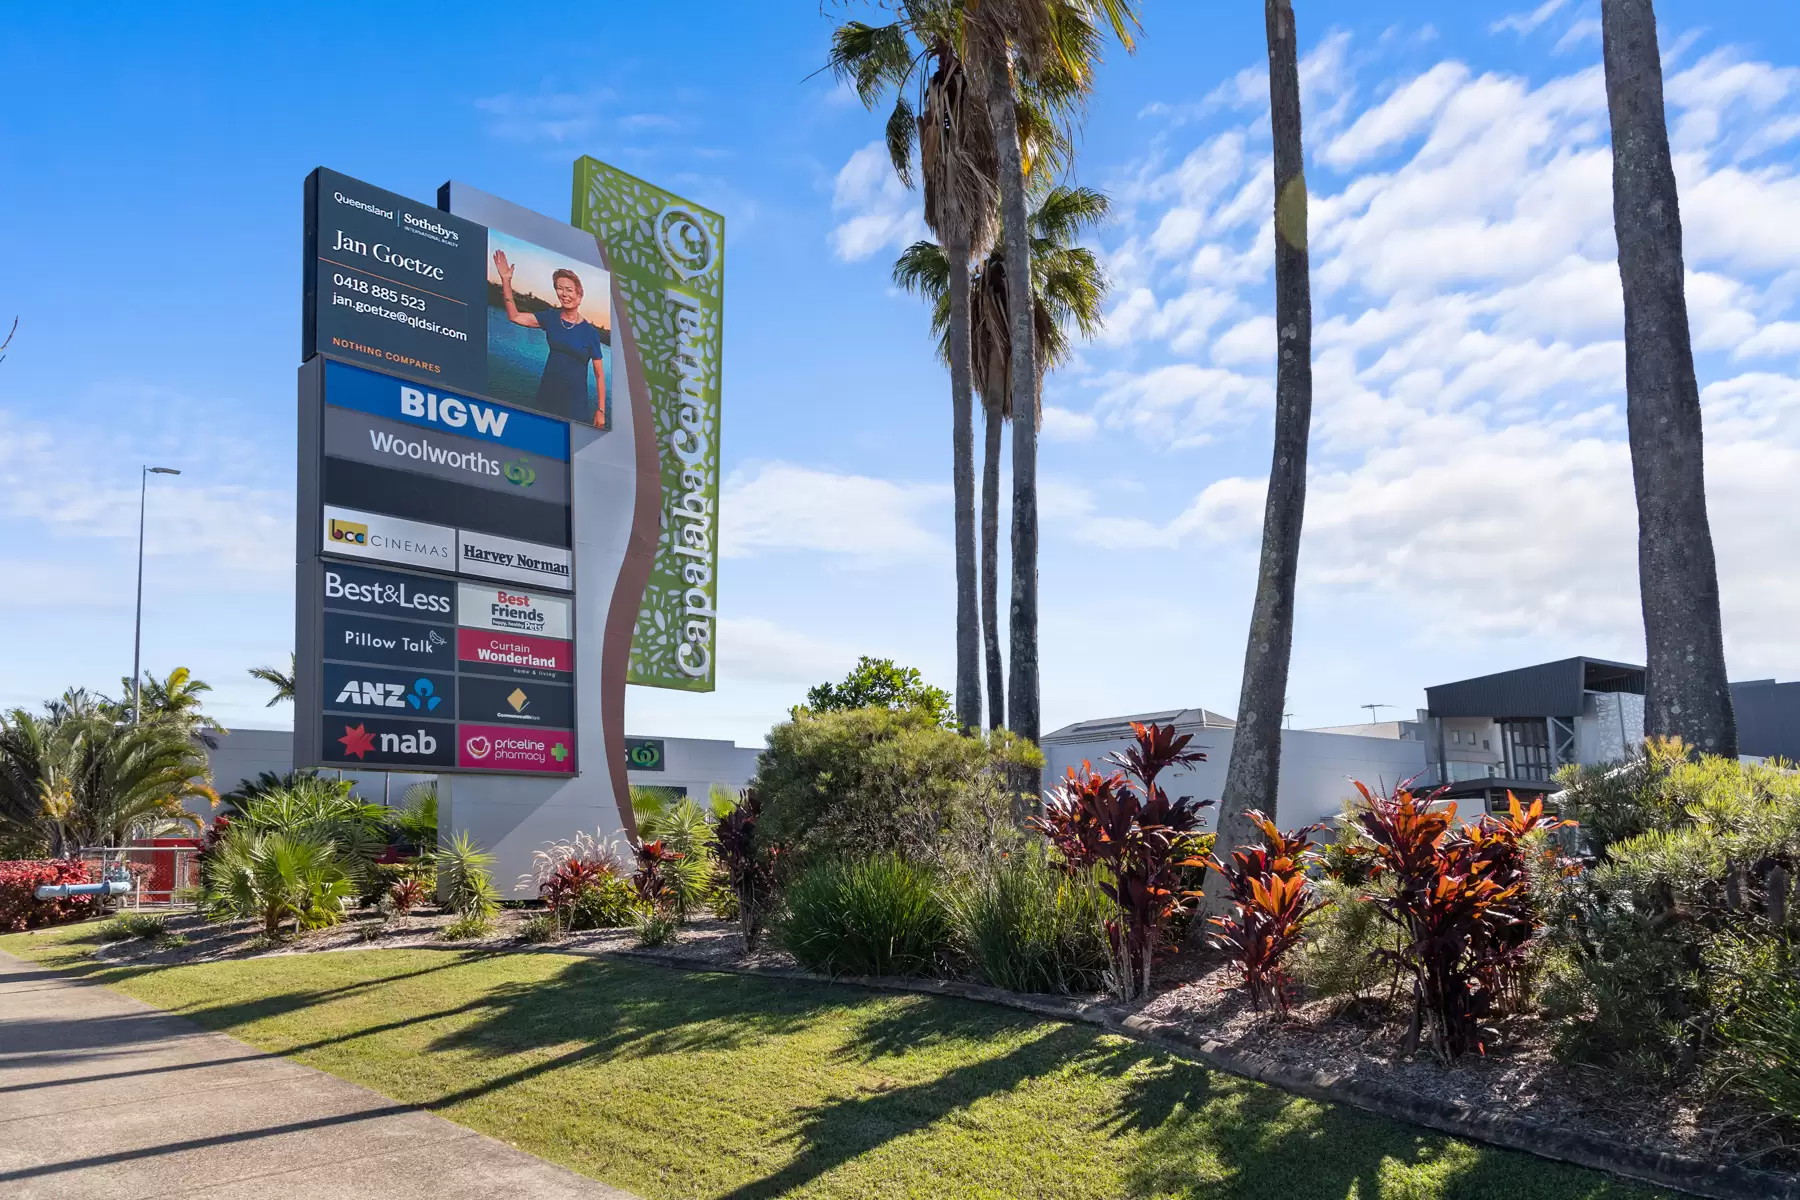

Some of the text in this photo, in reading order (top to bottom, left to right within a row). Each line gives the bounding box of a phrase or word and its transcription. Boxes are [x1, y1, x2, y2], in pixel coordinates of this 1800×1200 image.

[334, 191, 393, 220] Queensland
[404, 213, 459, 240] Sotheby's
[333, 230, 444, 281] Jan Goetze
[333, 273, 426, 311] 0418 885 523
[332, 292, 467, 342] jan.goetze@qldsir.com
[332, 337, 441, 374] NOTHING COMPARES
[369, 429, 500, 476] Woolworths
[331, 519, 448, 558] bcc CINEMAS
[463, 544, 570, 575] Harvey Norman
[492, 603, 544, 622] Friends
[497, 591, 530, 607] Best
[525, 621, 543, 632] Pets
[345, 630, 433, 653] Pillow Talk
[490, 640, 530, 653] Curtain
[477, 648, 555, 668] Wonderland
[335, 680, 406, 708] ANZ
[380, 729, 437, 755] nab
[494, 738, 545, 751] priceline
[494, 749, 546, 764] pharmacy
